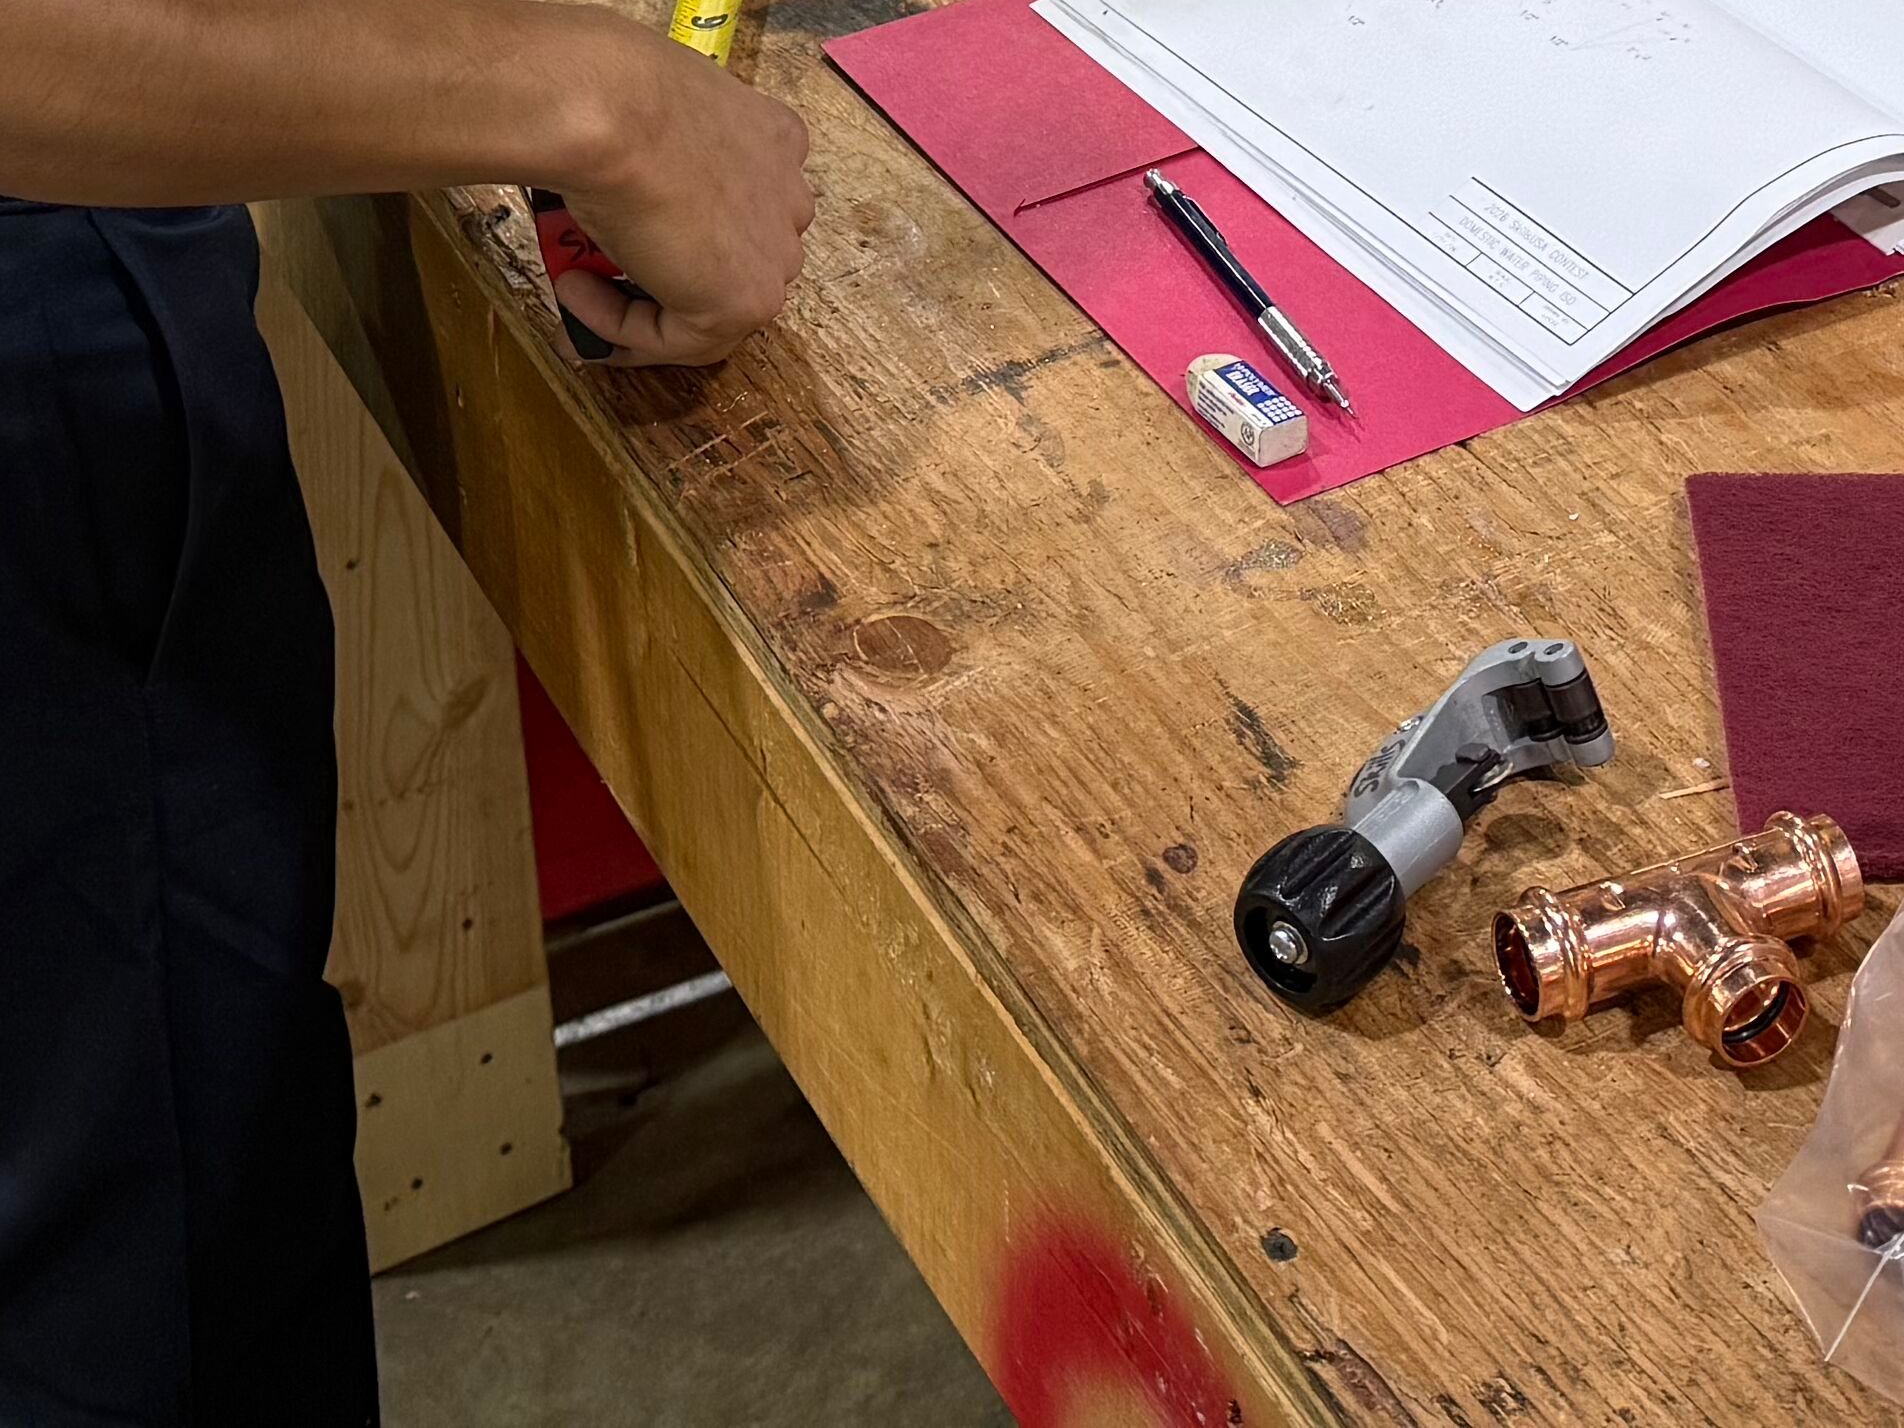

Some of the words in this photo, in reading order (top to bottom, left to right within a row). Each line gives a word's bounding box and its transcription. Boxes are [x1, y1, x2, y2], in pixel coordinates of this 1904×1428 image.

[691, 12, 728, 29] 9
[1458, 215, 1502, 251] DOMESTIC
[1499, 245, 1531, 273] WATER
[1548, 249, 1590, 281] CONTEST
